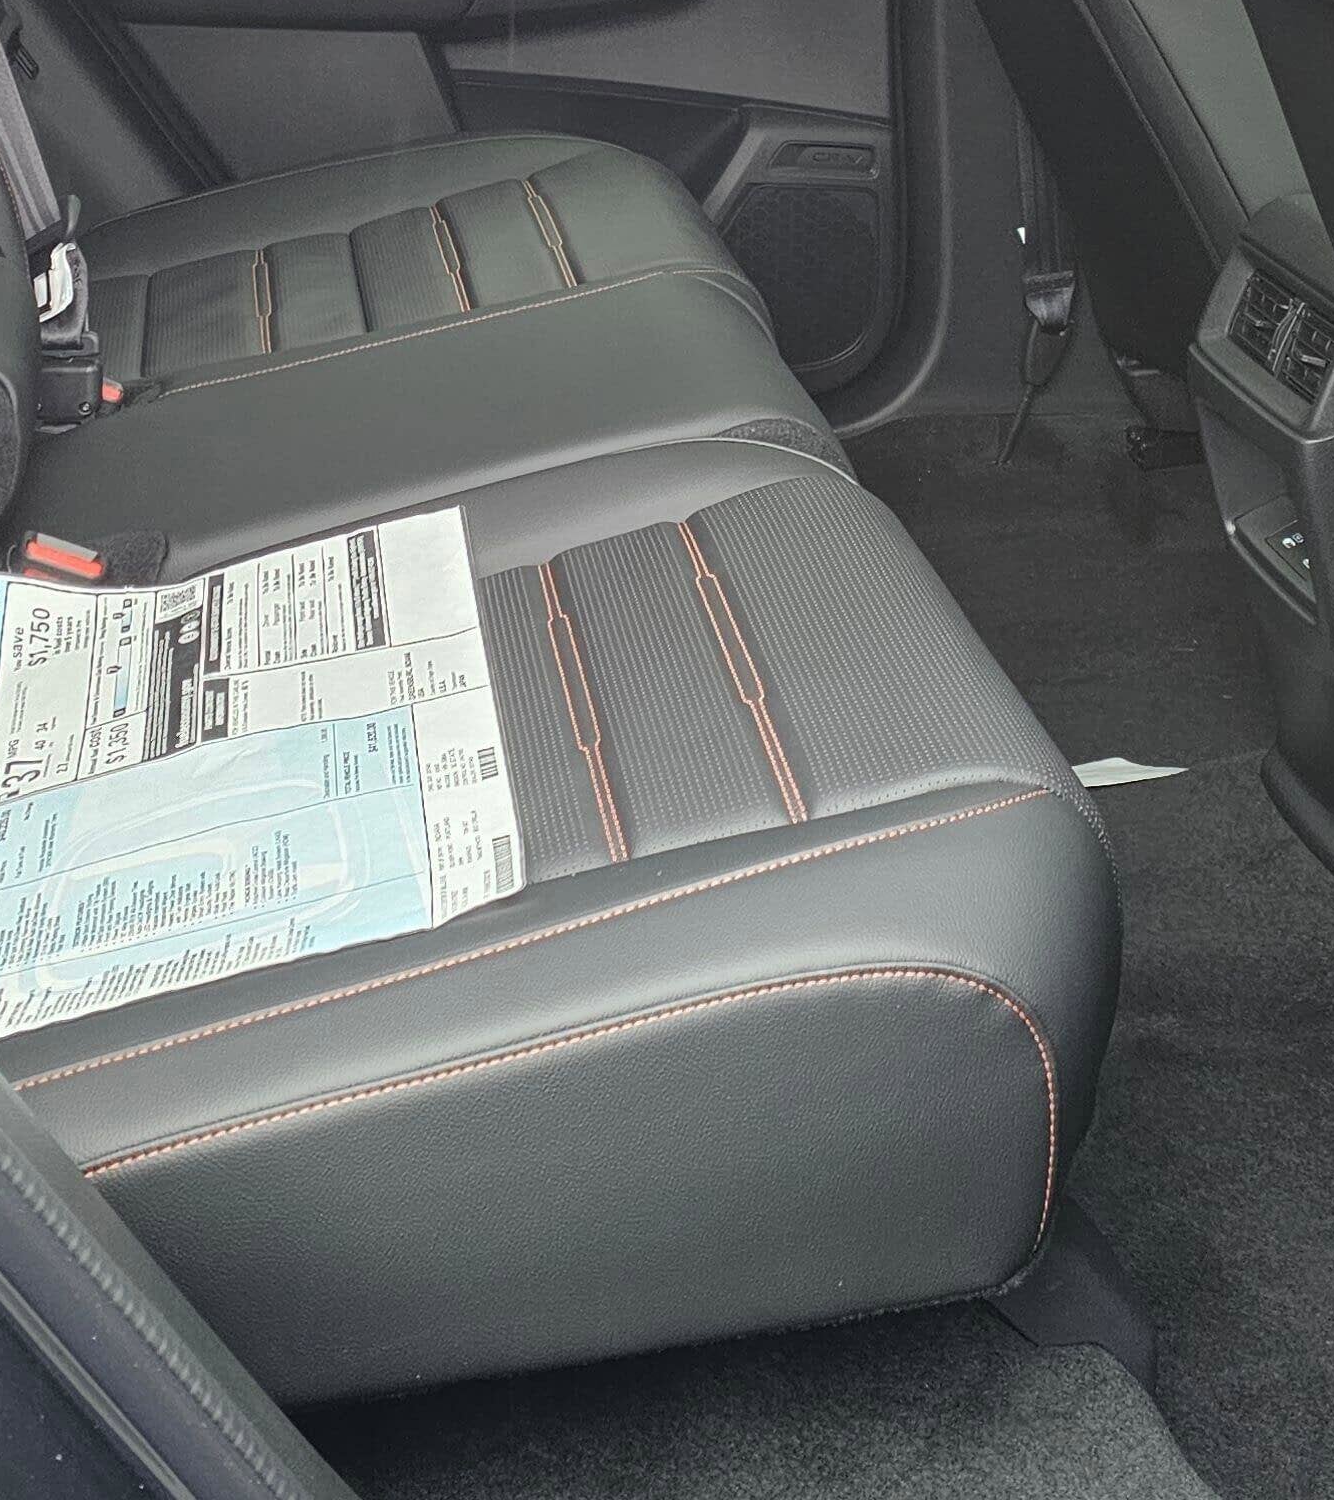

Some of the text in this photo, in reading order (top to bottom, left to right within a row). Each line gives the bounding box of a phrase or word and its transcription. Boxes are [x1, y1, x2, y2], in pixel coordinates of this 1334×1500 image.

[12, 627, 23, 657] save
[28, 608, 50, 665] $1,750
[7, 739, 19, 758] MPG
[105, 723, 128, 763] $1,350
[1, 760, 42, 787] 37
